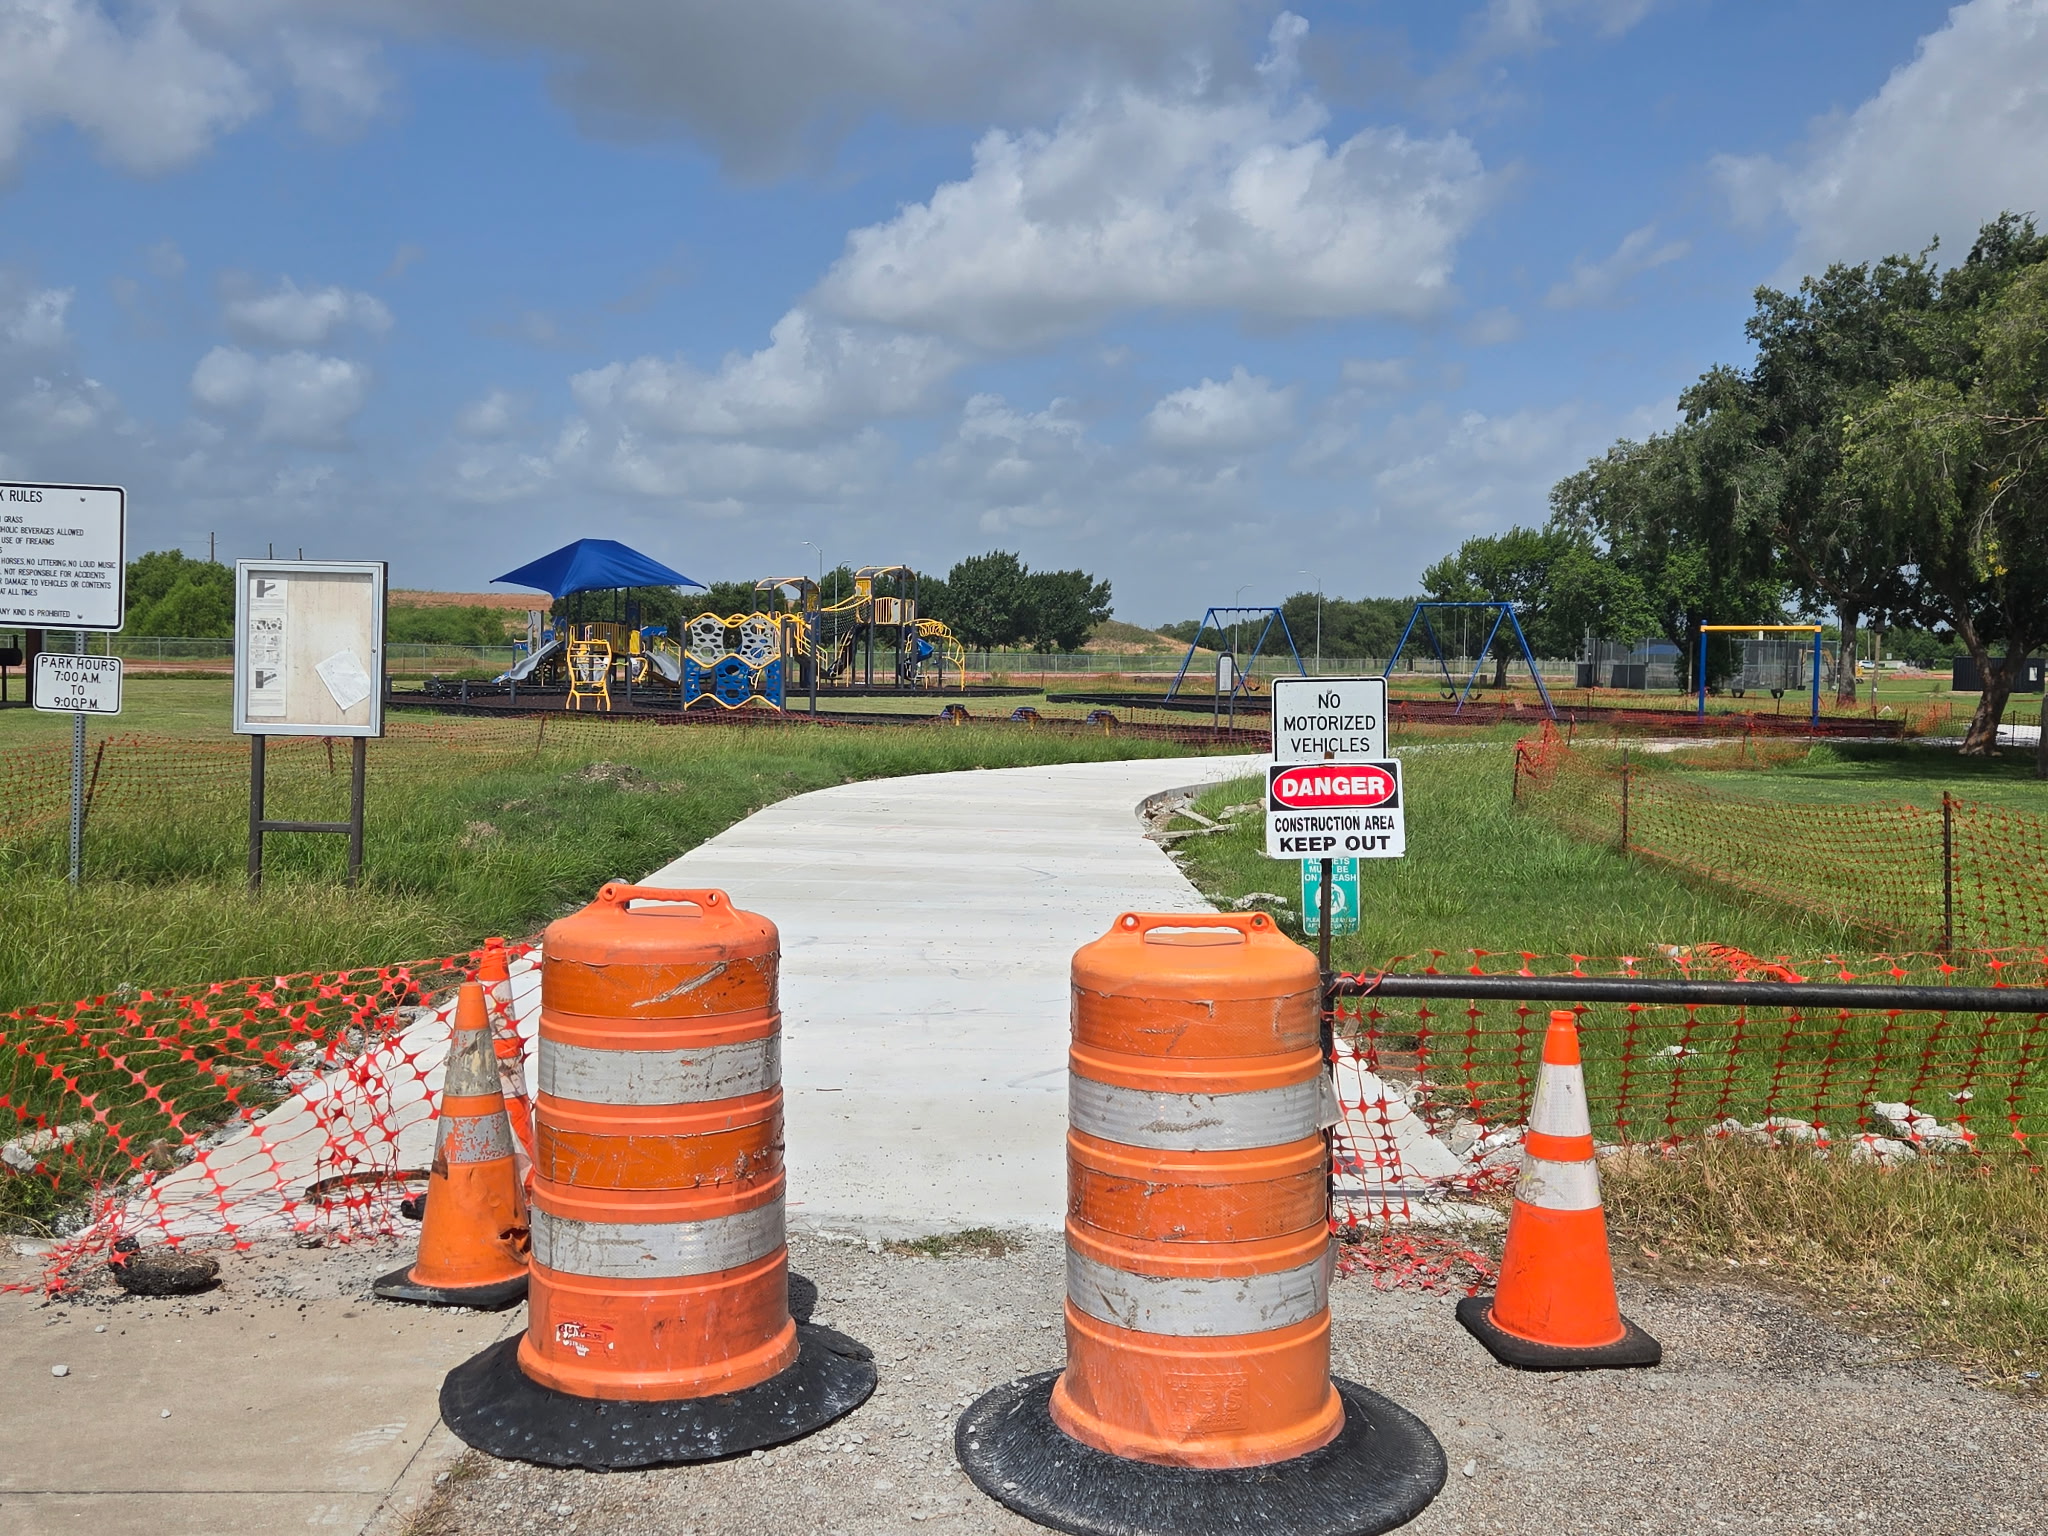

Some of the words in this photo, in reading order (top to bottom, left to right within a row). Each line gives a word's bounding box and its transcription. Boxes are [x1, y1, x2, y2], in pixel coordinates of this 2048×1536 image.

[10, 490, 43, 503] RULES
[21, 527, 54, 535] BEVERAGES
[57, 528, 84, 536] ALLOWED
[18, 569, 58, 577] RESPONSIBLE
[74, 571, 106, 579] ACCIDENTS
[5, 578, 28, 586] DAMAGE
[41, 580, 68, 588] VEHICLES
[82, 581, 112, 589] CONTENTS
[8, 588, 19, 596] ALL
[21, 589, 38, 597] TIMES
[13, 609, 27, 617] KIND
[29, 609, 35, 617] IS
[37, 610, 71, 618] PROHIBITED
[41, 657, 73, 669] PARK
[76, 660, 116, 672] HOURS
[54, 671, 79, 682] 7:00
[71, 685, 85, 696] TO
[54, 697, 79, 708] 9:00
[1318, 693, 1341, 709] NO
[1283, 715, 1376, 731] MOTORIZED
[1291, 737, 1370, 753] VEHICLES
[1282, 776, 1386, 798] DANGER
[1275, 815, 1360, 832] CONSTRUCTION
[1364, 815, 1395, 830] AREA
[1280, 836, 1337, 852] KEEP
[1345, 835, 1391, 851] OUT
[1332, 857, 1350, 865] ETS
[1336, 865, 1349, 873] BE
[1304, 874, 1317, 882] ON
